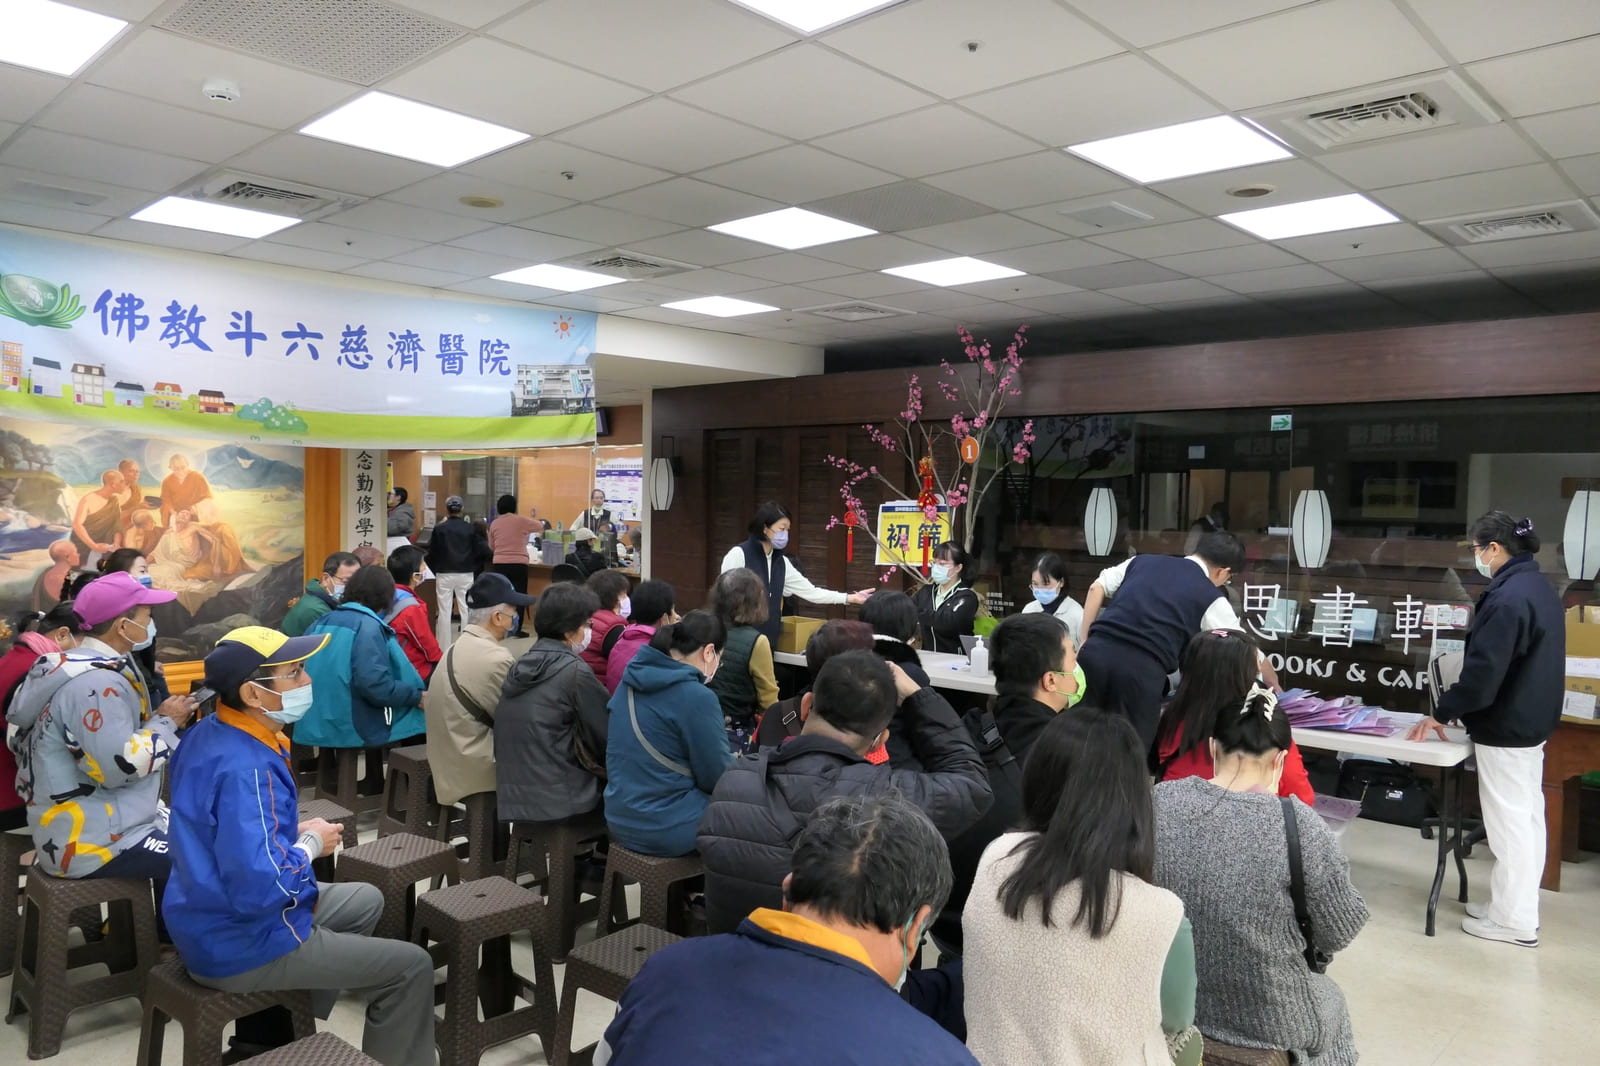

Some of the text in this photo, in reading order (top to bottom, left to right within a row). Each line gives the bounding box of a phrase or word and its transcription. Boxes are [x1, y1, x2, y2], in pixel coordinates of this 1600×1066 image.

[93, 288, 512, 376] 佛教斗六慈濟醫院
[966, 444, 973, 459] 1
[355, 450, 374, 547] 念勤修學
[887, 523, 943, 549] 初篩
[1243, 582, 1454, 657] 思書軒
[1267, 653, 1429, 690] OOKS & CAF
[143, 836, 169, 854] WE
